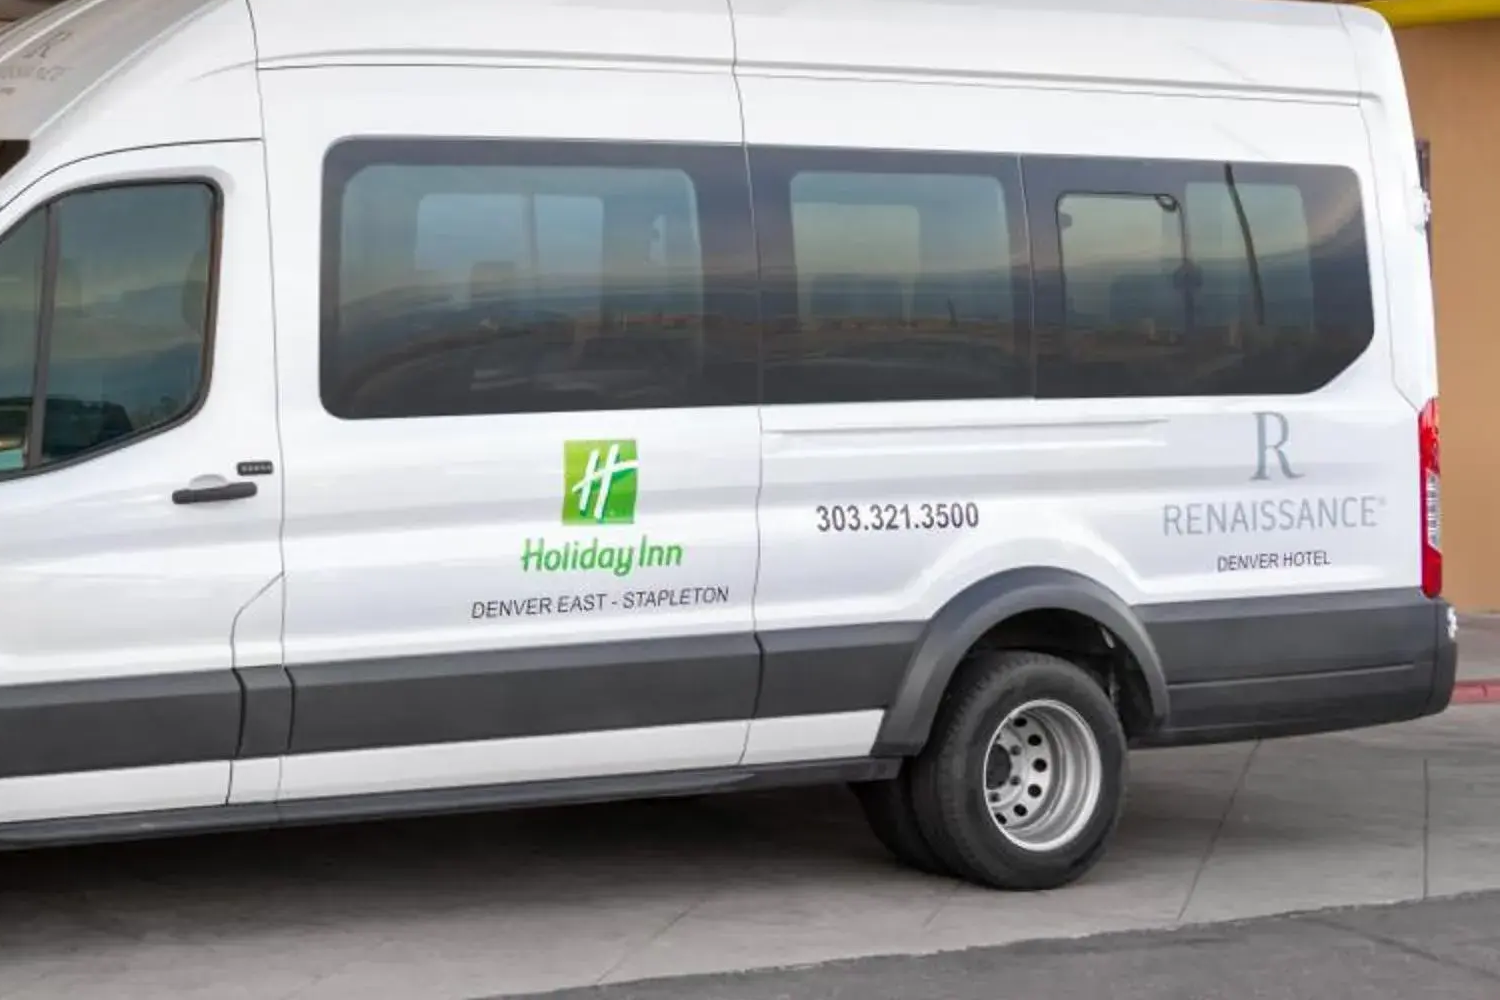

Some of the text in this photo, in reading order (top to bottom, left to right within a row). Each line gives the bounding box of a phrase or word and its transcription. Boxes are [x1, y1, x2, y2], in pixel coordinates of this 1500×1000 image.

[1249, 411, 1304, 481] R
[815, 501, 980, 532] 303.321.3500
[520, 534, 683, 577] Holiday Inn
[1217, 550, 1332, 573] DENVER HOTEL
[471, 595, 552, 619] DENVER
[556, 592, 608, 614] EAST
[622, 585, 730, 610] STAPLETON
